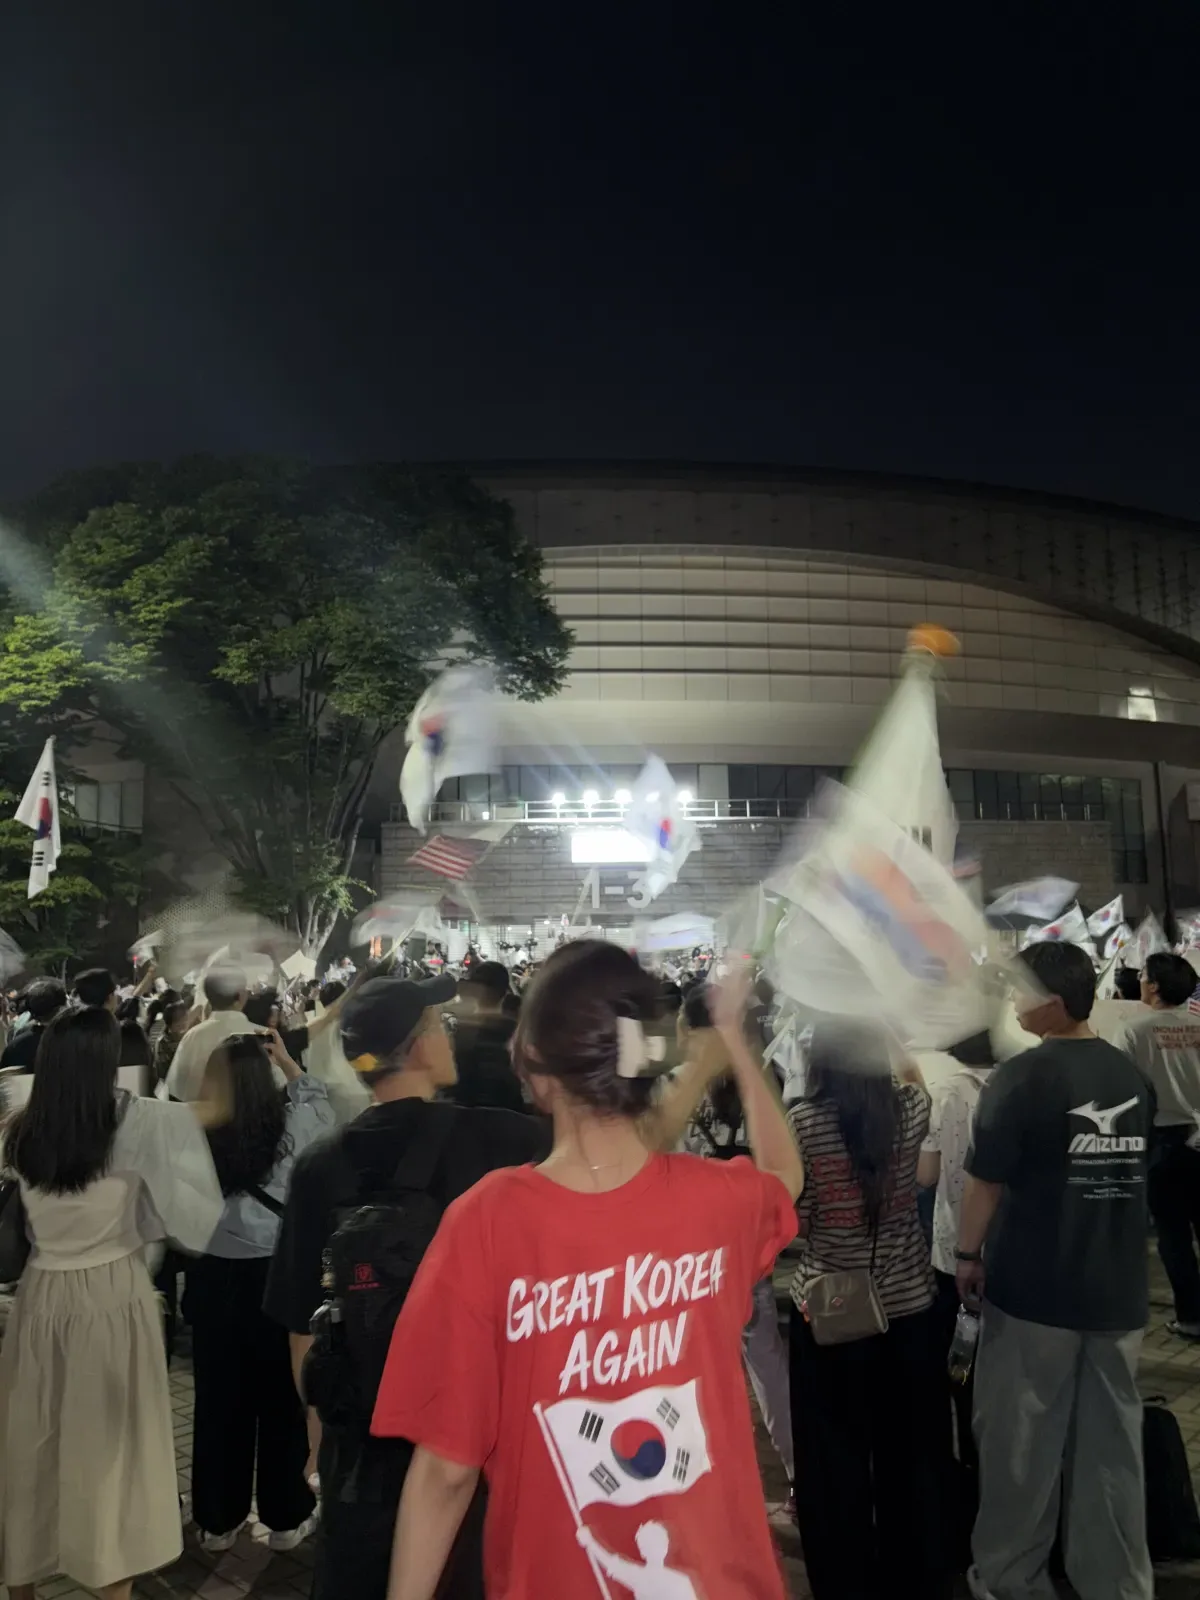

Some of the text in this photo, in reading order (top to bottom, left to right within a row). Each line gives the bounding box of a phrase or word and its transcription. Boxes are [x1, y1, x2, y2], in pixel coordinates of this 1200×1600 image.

[581, 869, 652, 909] 1-3
[1067, 1133, 1146, 1153] MIZUNO
[506, 1247, 724, 1343] GREAT KOREA
[558, 1310, 688, 1396] AGAIN
